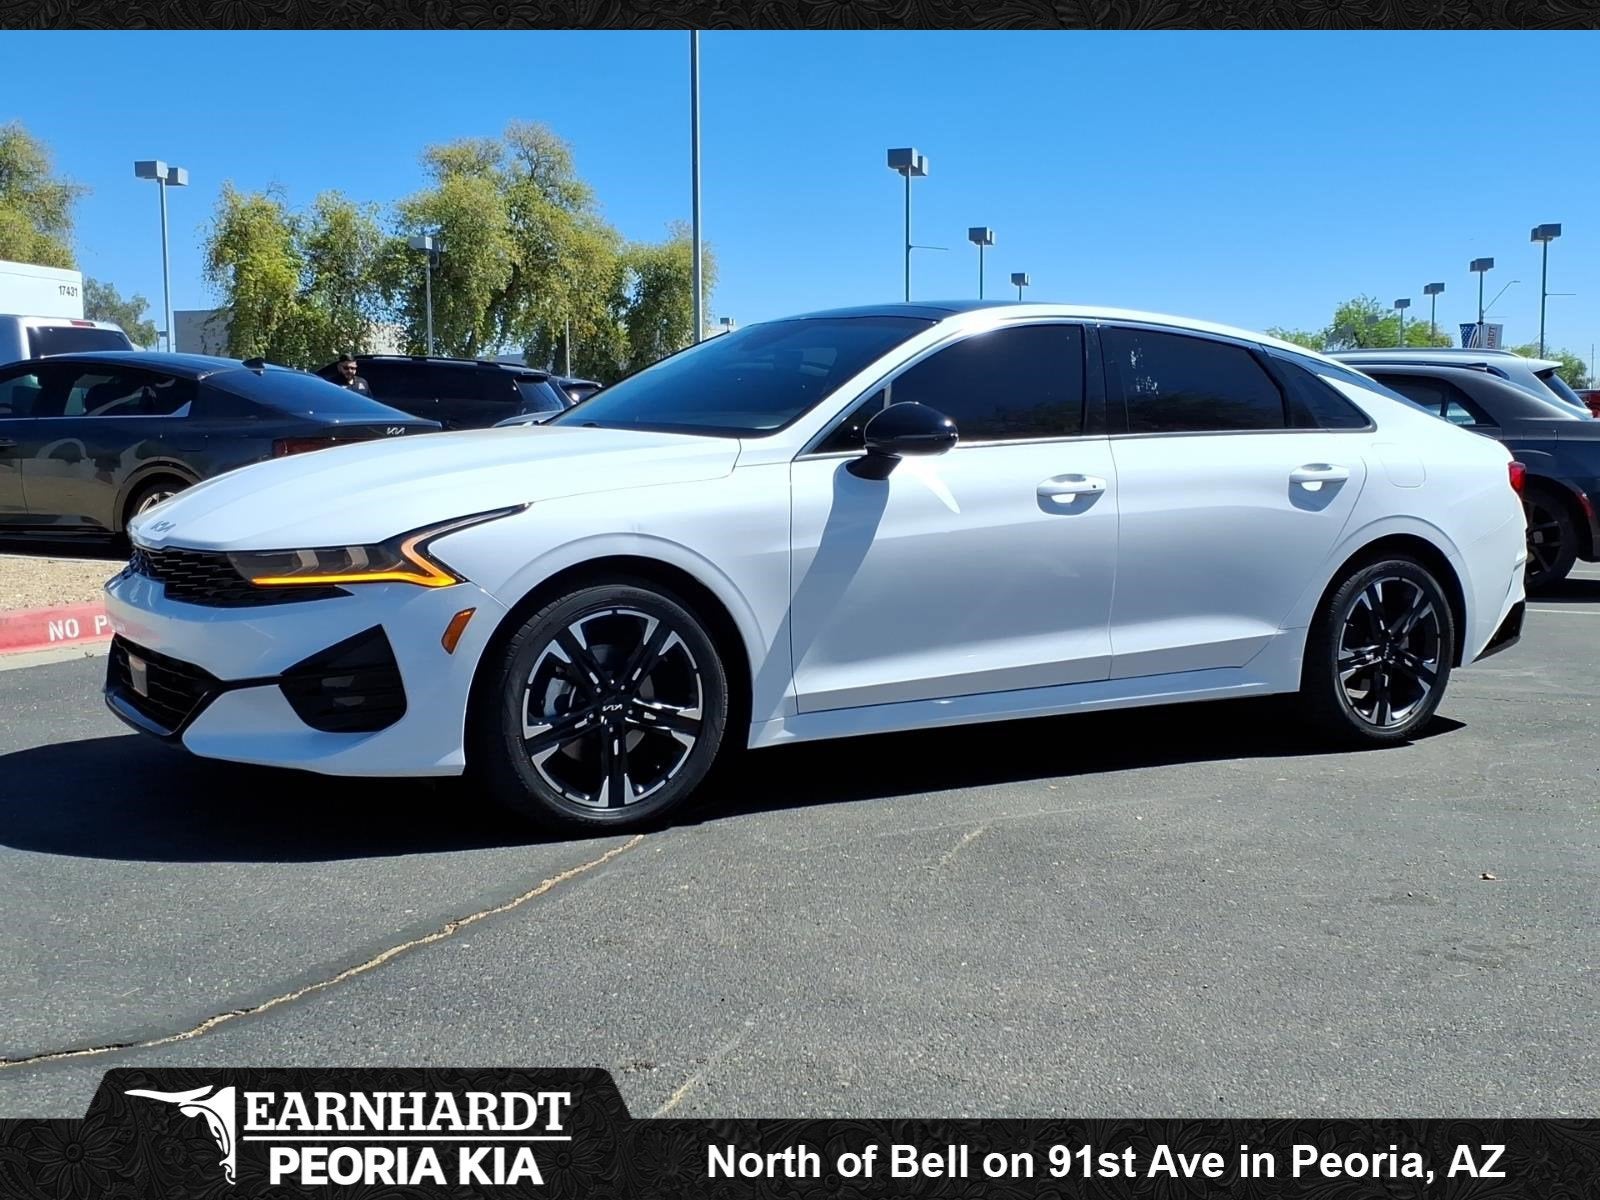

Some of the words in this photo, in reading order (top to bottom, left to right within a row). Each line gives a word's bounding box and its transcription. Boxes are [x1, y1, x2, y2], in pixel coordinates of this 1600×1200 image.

[58, 285, 78, 297] 17431
[386, 427, 405, 435] KIA
[48, 618, 79, 642] NO
[95, 614, 112, 635] P
